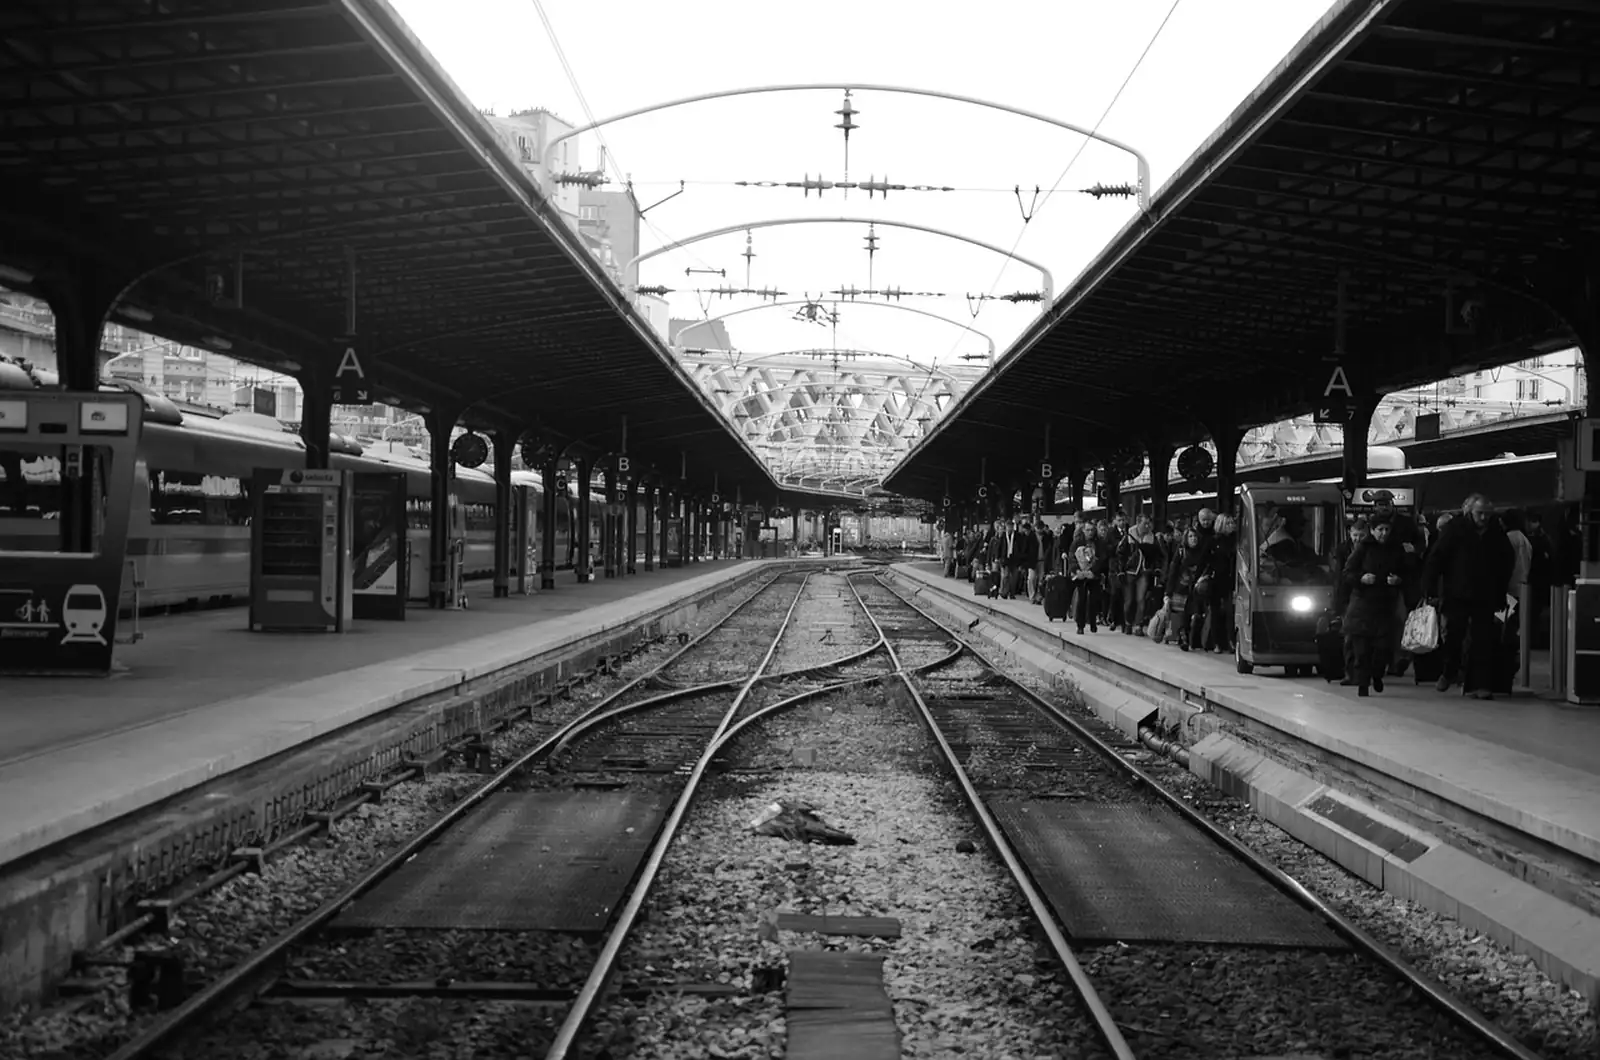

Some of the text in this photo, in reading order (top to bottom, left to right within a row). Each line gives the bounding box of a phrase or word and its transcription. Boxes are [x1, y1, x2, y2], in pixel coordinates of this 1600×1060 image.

[335, 347, 365, 378] A
[1323, 365, 1354, 397] A
[1347, 410, 1355, 421] 7
[618, 457, 630, 472] B
[1041, 463, 1053, 478] B
[556, 478, 566, 490] C
[711, 493, 720, 503] D
[978, 486, 988, 498] C
[943, 498, 951, 507] D
